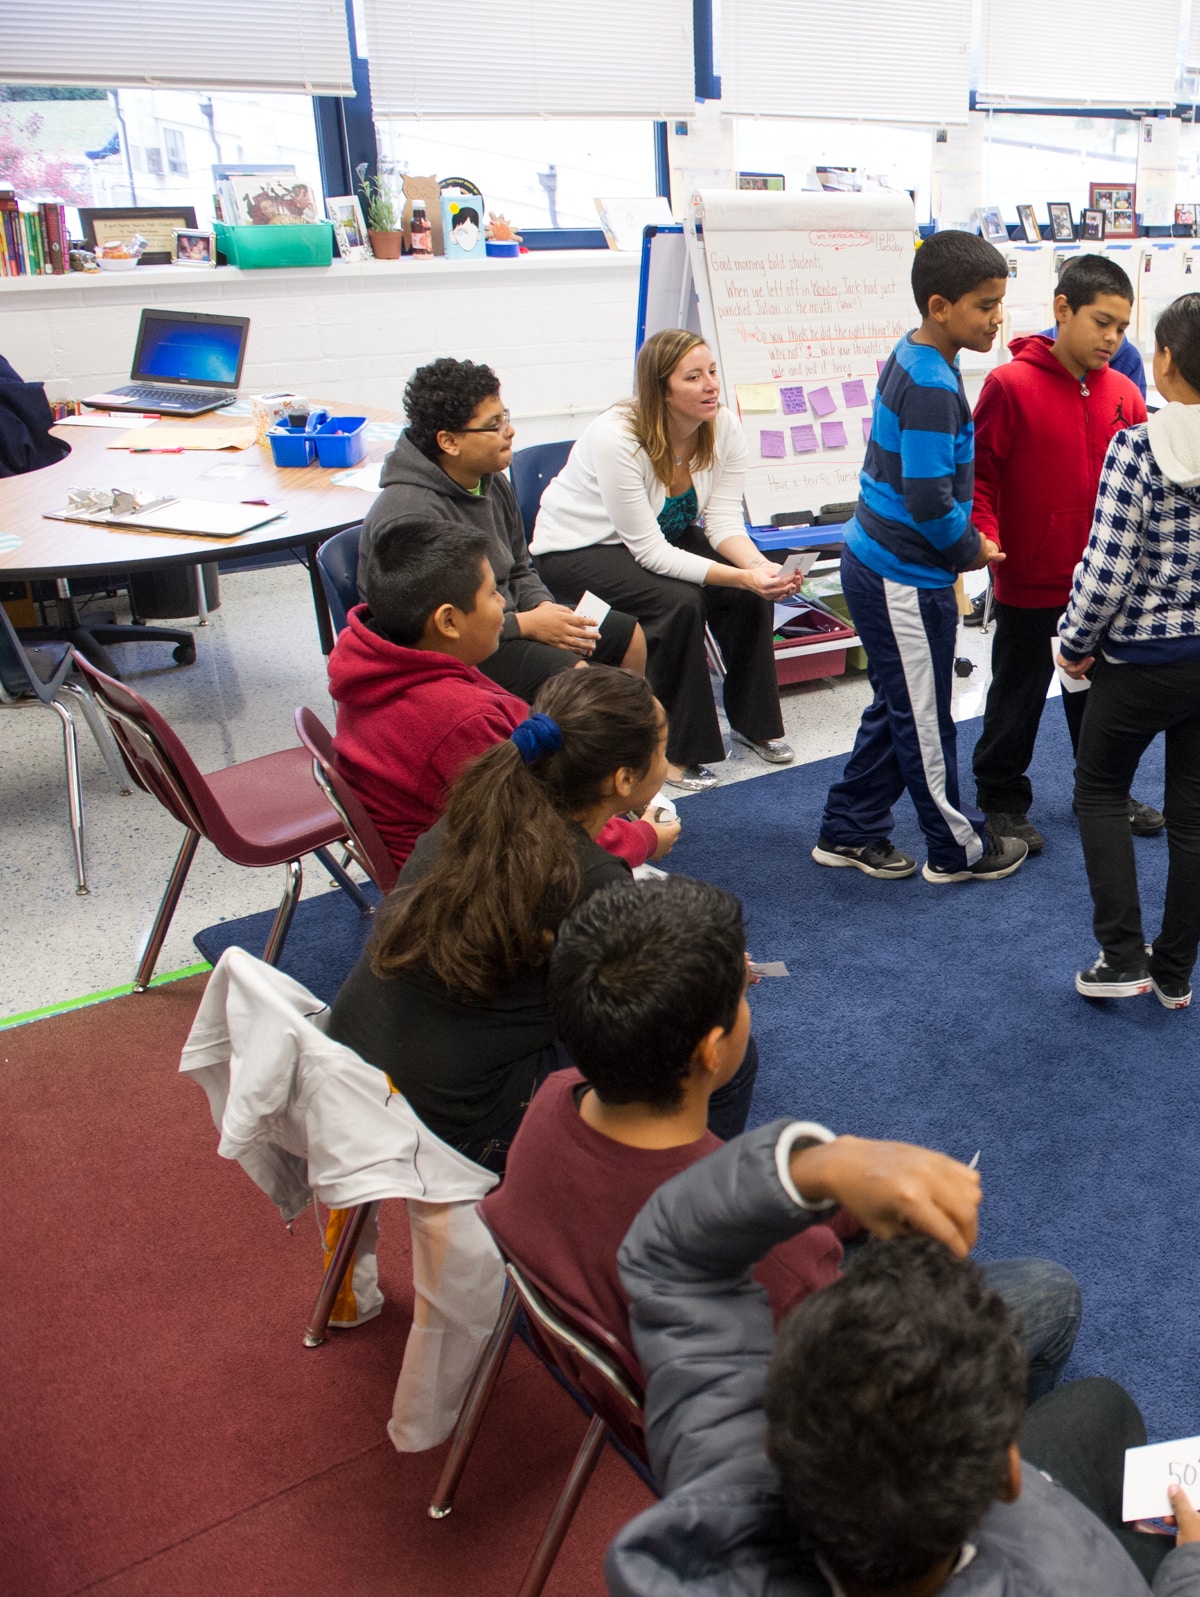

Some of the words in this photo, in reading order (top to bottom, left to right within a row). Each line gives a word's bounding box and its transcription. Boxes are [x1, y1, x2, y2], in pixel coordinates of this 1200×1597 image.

[710, 252, 732, 272] Good
[735, 255, 767, 277] morning
[768, 253, 785, 270] bold
[789, 252, 824, 272] students,
[725, 279, 748, 299] When
[751, 286, 764, 298] we
[766, 278, 783, 298] left
[786, 278, 800, 297] off
[802, 283, 810, 296] in
[841, 276, 861, 295] Jack
[863, 278, 877, 294] had
[879, 278, 897, 300] just
[718, 301, 752, 321] punched
[754, 299, 781, 316] Julian
[784, 302, 792, 314] in
[796, 299, 807, 314] the
[809, 298, 833, 314] mouth
[756, 325, 767, 343] Do
[769, 330, 783, 345] you
[787, 325, 808, 341] think
[809, 324, 818, 340] he
[821, 322, 832, 339] did
[834, 321, 846, 338] the
[846, 321, 866, 341] right
[769, 346, 784, 361] why
[787, 343, 803, 359] not?
[838, 346, 850, 358] your
[853, 341, 881, 358] thoughts
[771, 363, 784, 377] note
[789, 362, 802, 377] and
[805, 361, 817, 378] post
[820, 360, 827, 374] it
[767, 471, 789, 490] Have
[793, 480, 799, 488] a
[803, 471, 831, 488] terrific
[835, 467, 859, 484] Tuesd
